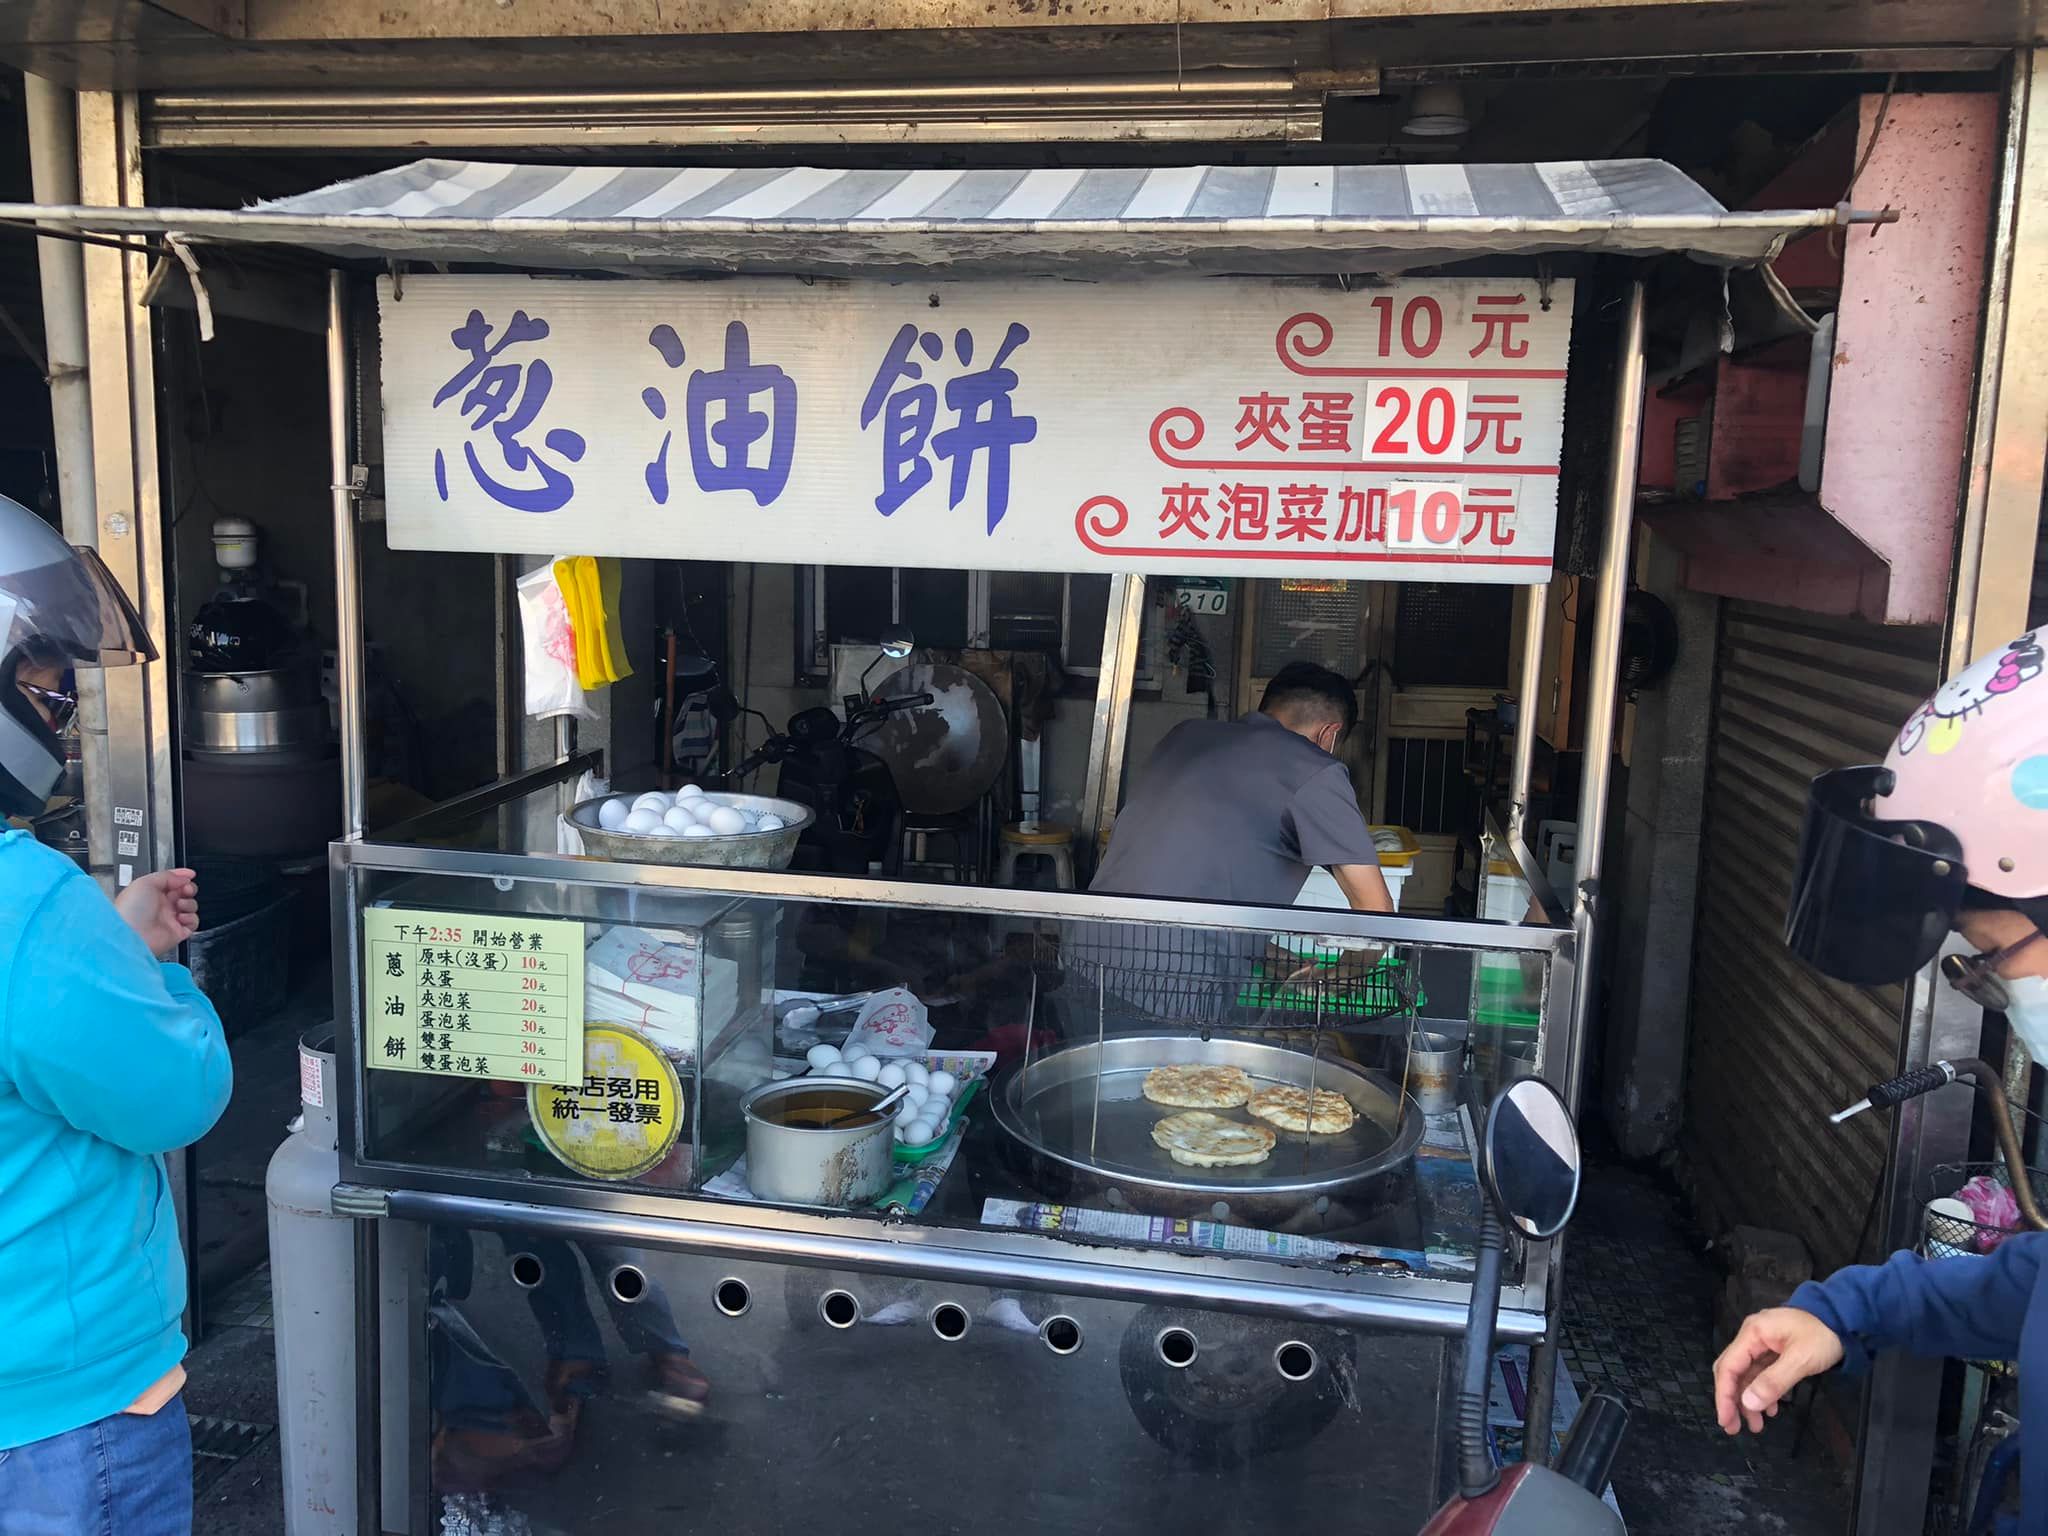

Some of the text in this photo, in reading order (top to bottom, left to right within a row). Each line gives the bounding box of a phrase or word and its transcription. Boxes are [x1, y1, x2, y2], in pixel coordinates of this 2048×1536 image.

[1179, 591, 1225, 612] 210
[420, 968, 454, 987] 夾蛋
[420, 989, 472, 1010] 夾泡菜
[420, 1010, 472, 1031] 蛋泡菜
[420, 1031, 454, 1050] 雙蛋
[420, 1052, 490, 1075] 雙蛋泡菜
[552, 1096, 662, 1125] 統一發票
